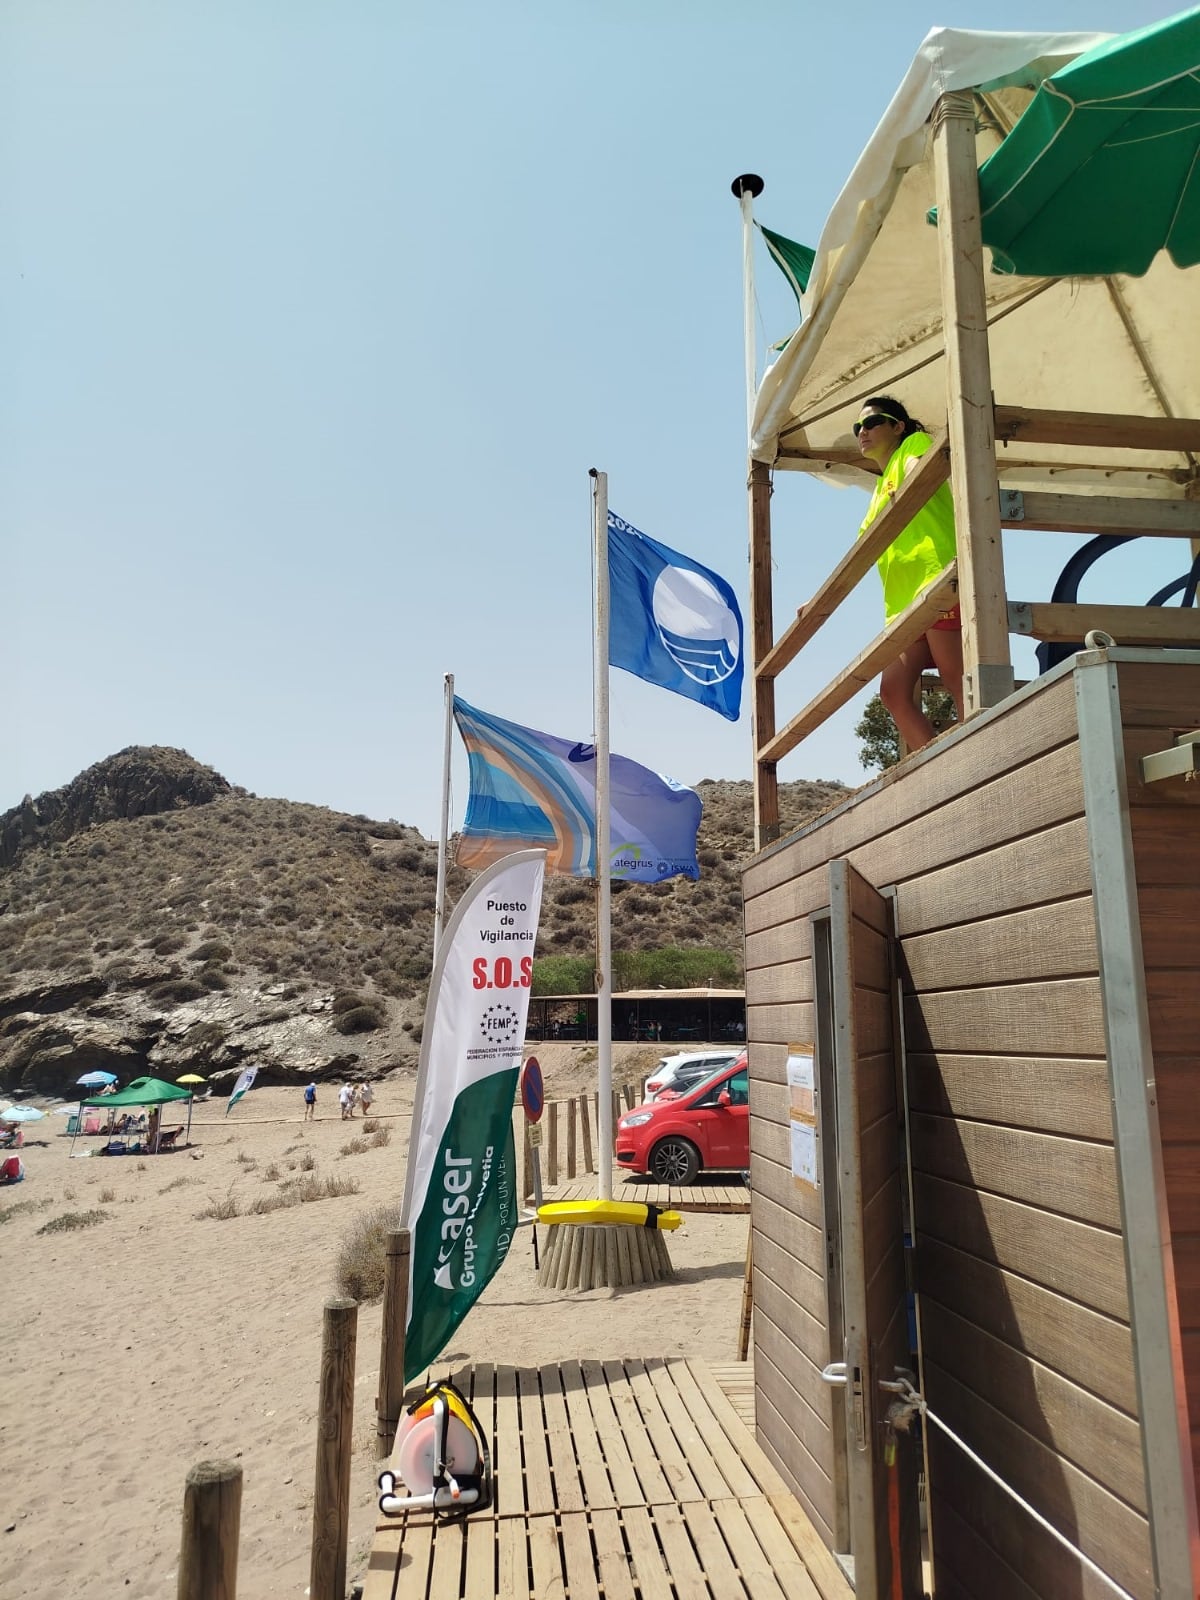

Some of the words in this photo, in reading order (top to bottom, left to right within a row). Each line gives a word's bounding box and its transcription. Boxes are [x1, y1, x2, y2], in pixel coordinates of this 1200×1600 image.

[614, 858, 653, 870] ategrus
[487, 900, 527, 912] Puesto
[500, 915, 515, 926] de
[480, 930, 533, 943] Vigilancia
[487, 1017, 512, 1030] FEMP
[500, 1200, 510, 1226] POR
[460, 1225, 478, 1288] Grupo
